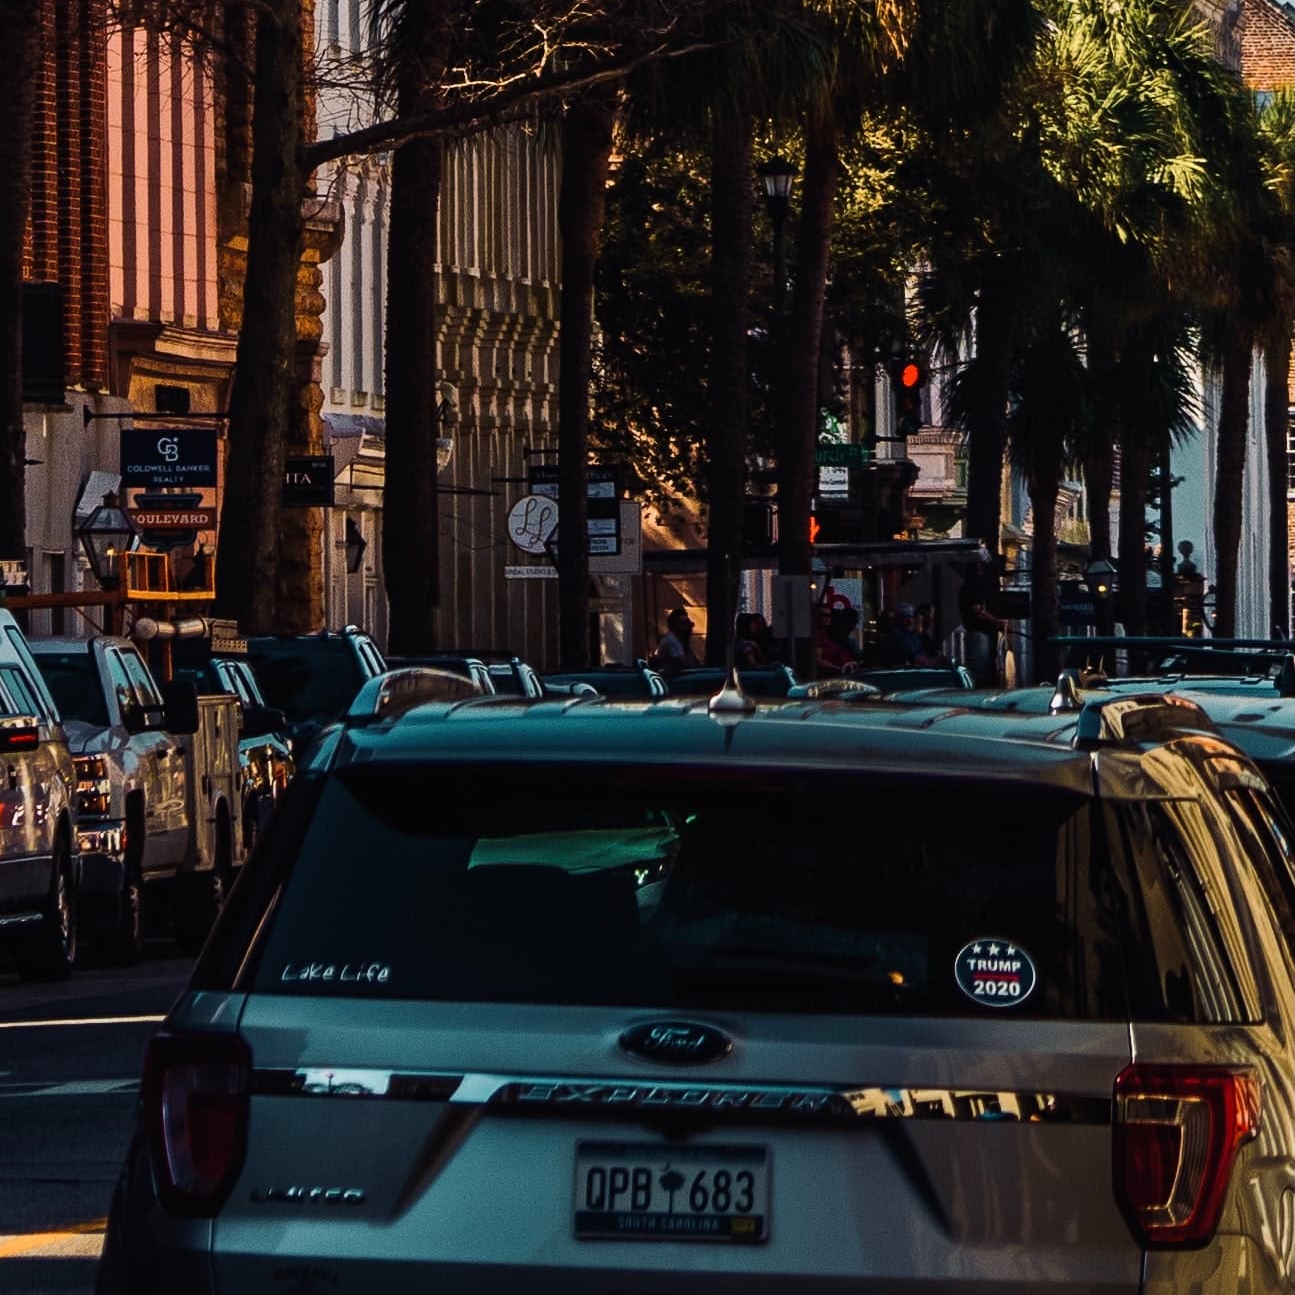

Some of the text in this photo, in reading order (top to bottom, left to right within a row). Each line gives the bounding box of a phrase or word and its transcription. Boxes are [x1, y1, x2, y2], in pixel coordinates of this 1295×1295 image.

[127, 464, 210, 473] COLDWELL BANKER
[132, 513, 209, 525] OULEVARD
[281, 961, 392, 983] Lake Life
[966, 958, 1022, 973] TRUMP
[973, 980, 1021, 997] 2020
[640, 1026, 706, 1050] Ford
[517, 1082, 830, 1111] EXPLORER
[586, 1166, 755, 1213] QPB 683
[615, 1215, 656, 1232] SOUTH
[662, 1216, 721, 1234] CAROLINA
